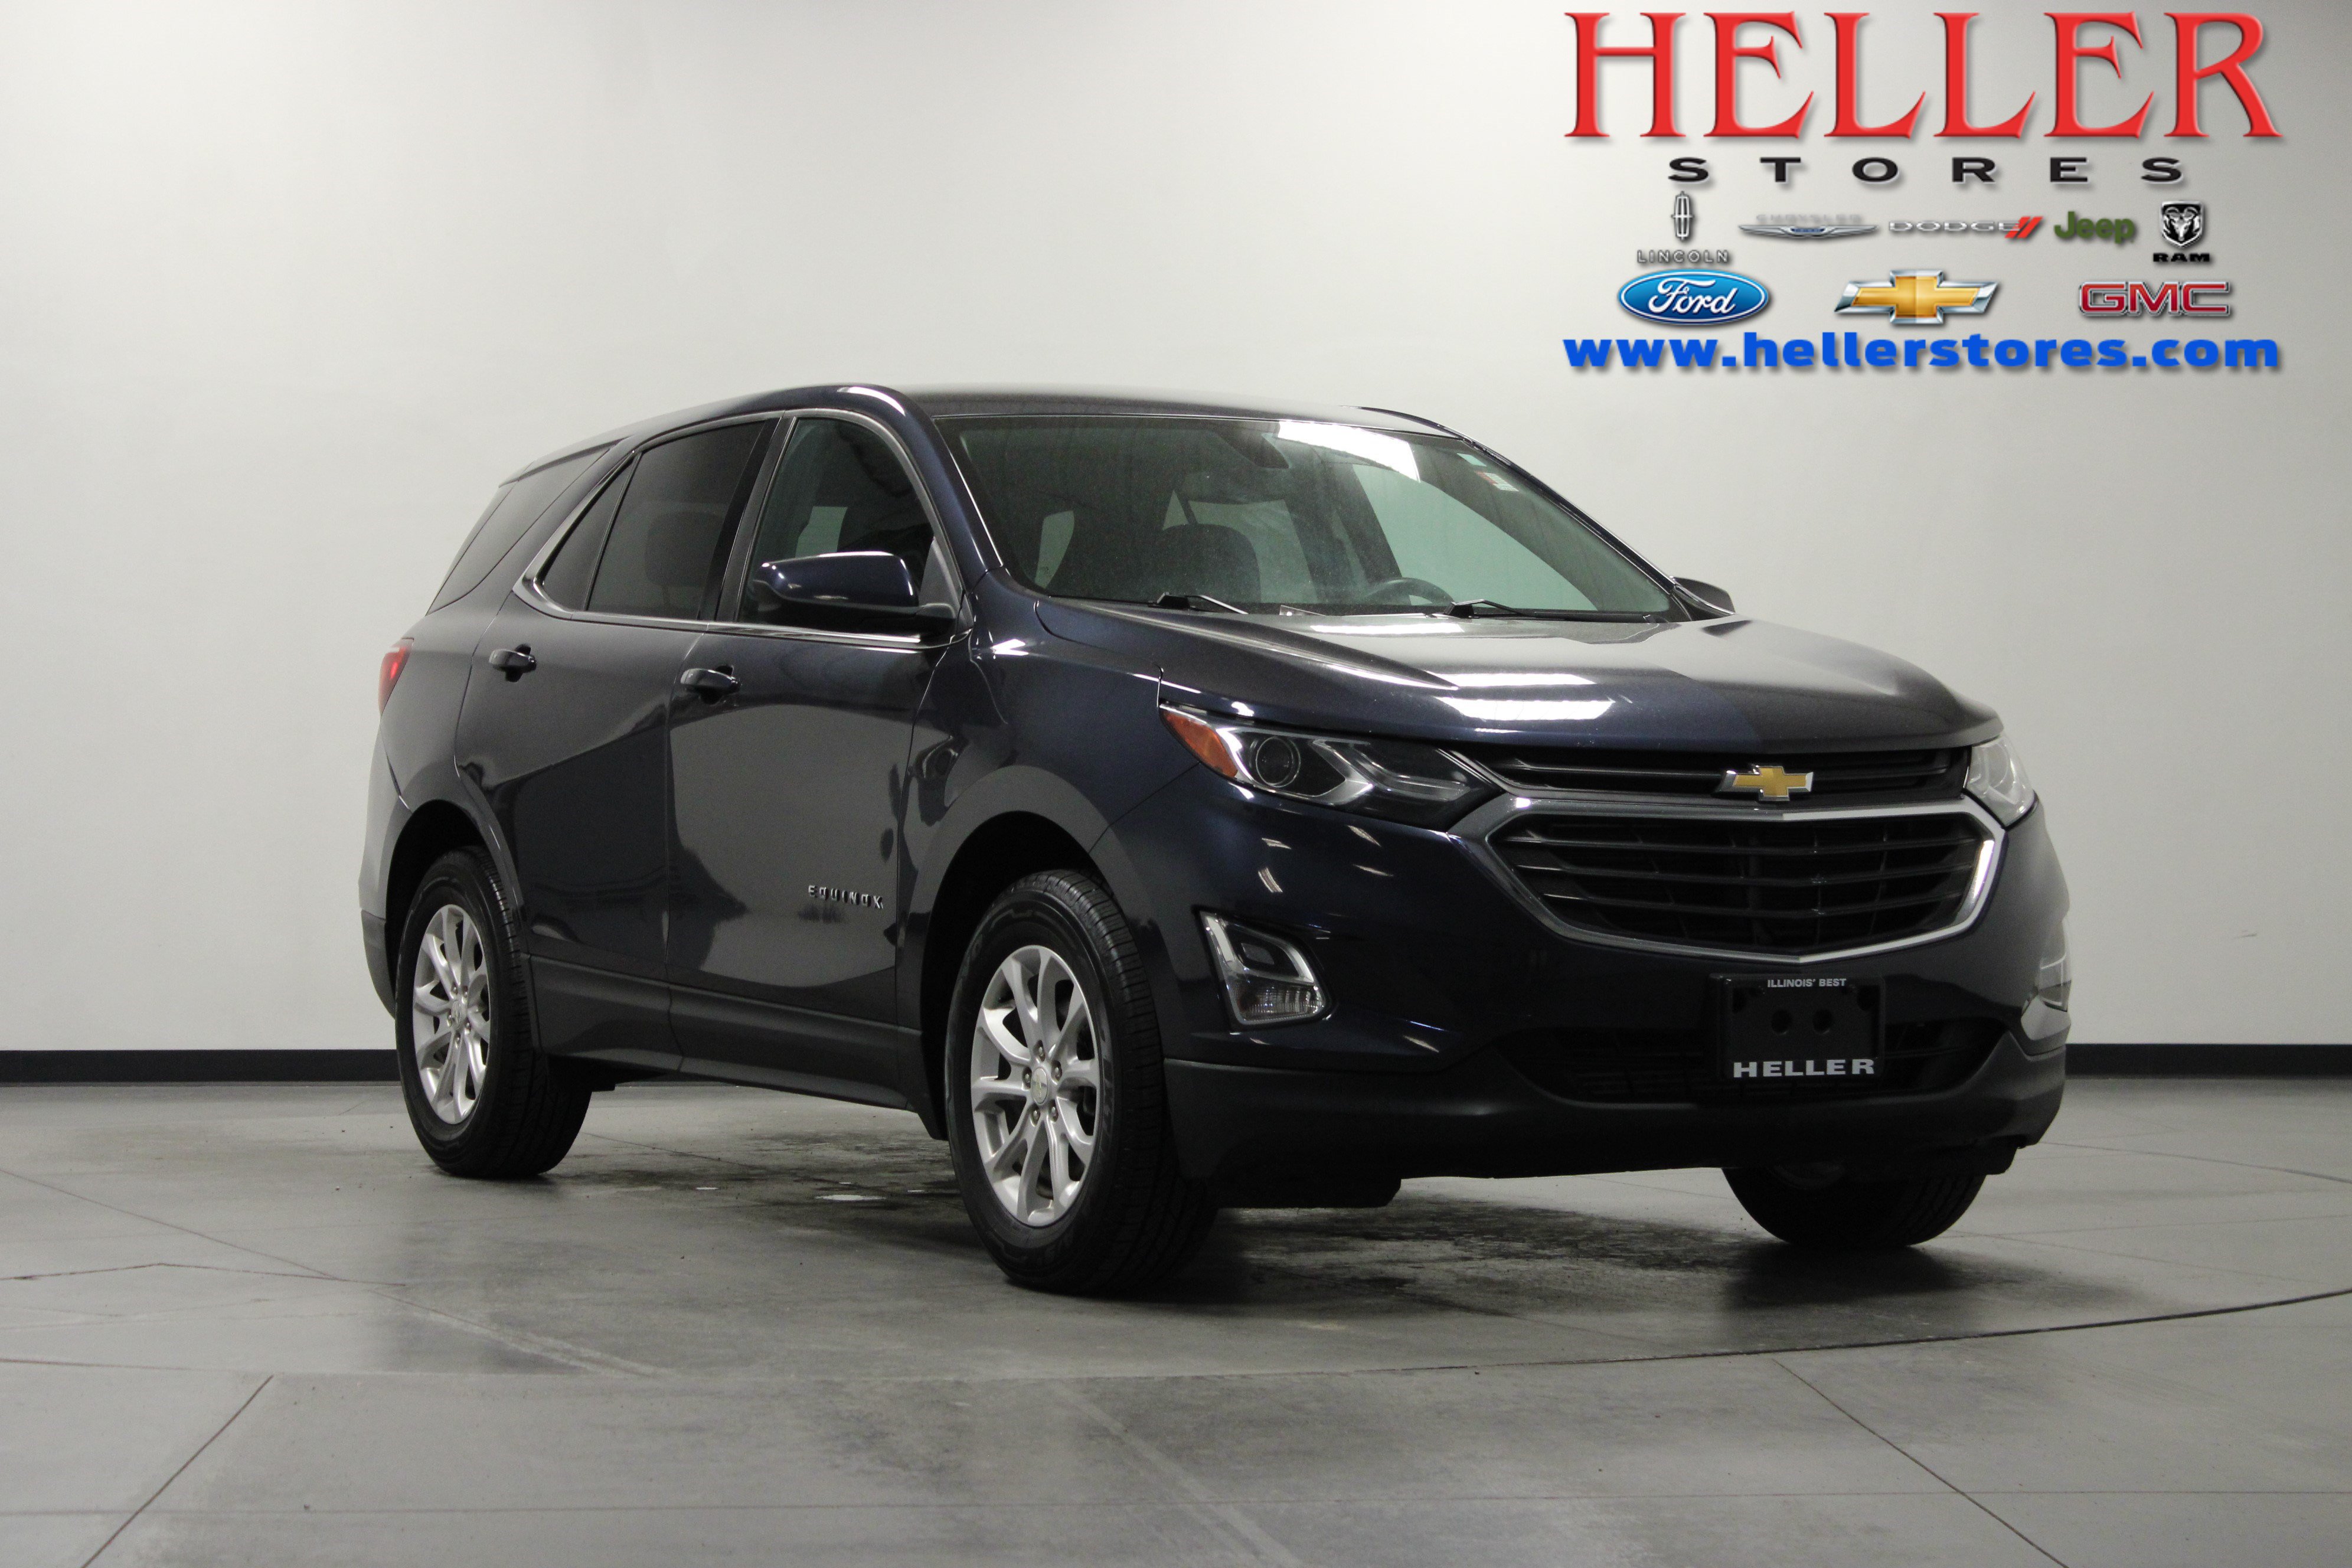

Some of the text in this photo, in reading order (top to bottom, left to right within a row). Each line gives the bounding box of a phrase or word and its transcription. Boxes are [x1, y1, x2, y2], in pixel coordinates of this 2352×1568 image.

[808, 884, 884, 910] EQUINOX
[1767, 978, 1847, 988] ILLINOIS' BEST
[1733, 1058, 1875, 1078] HELLER
